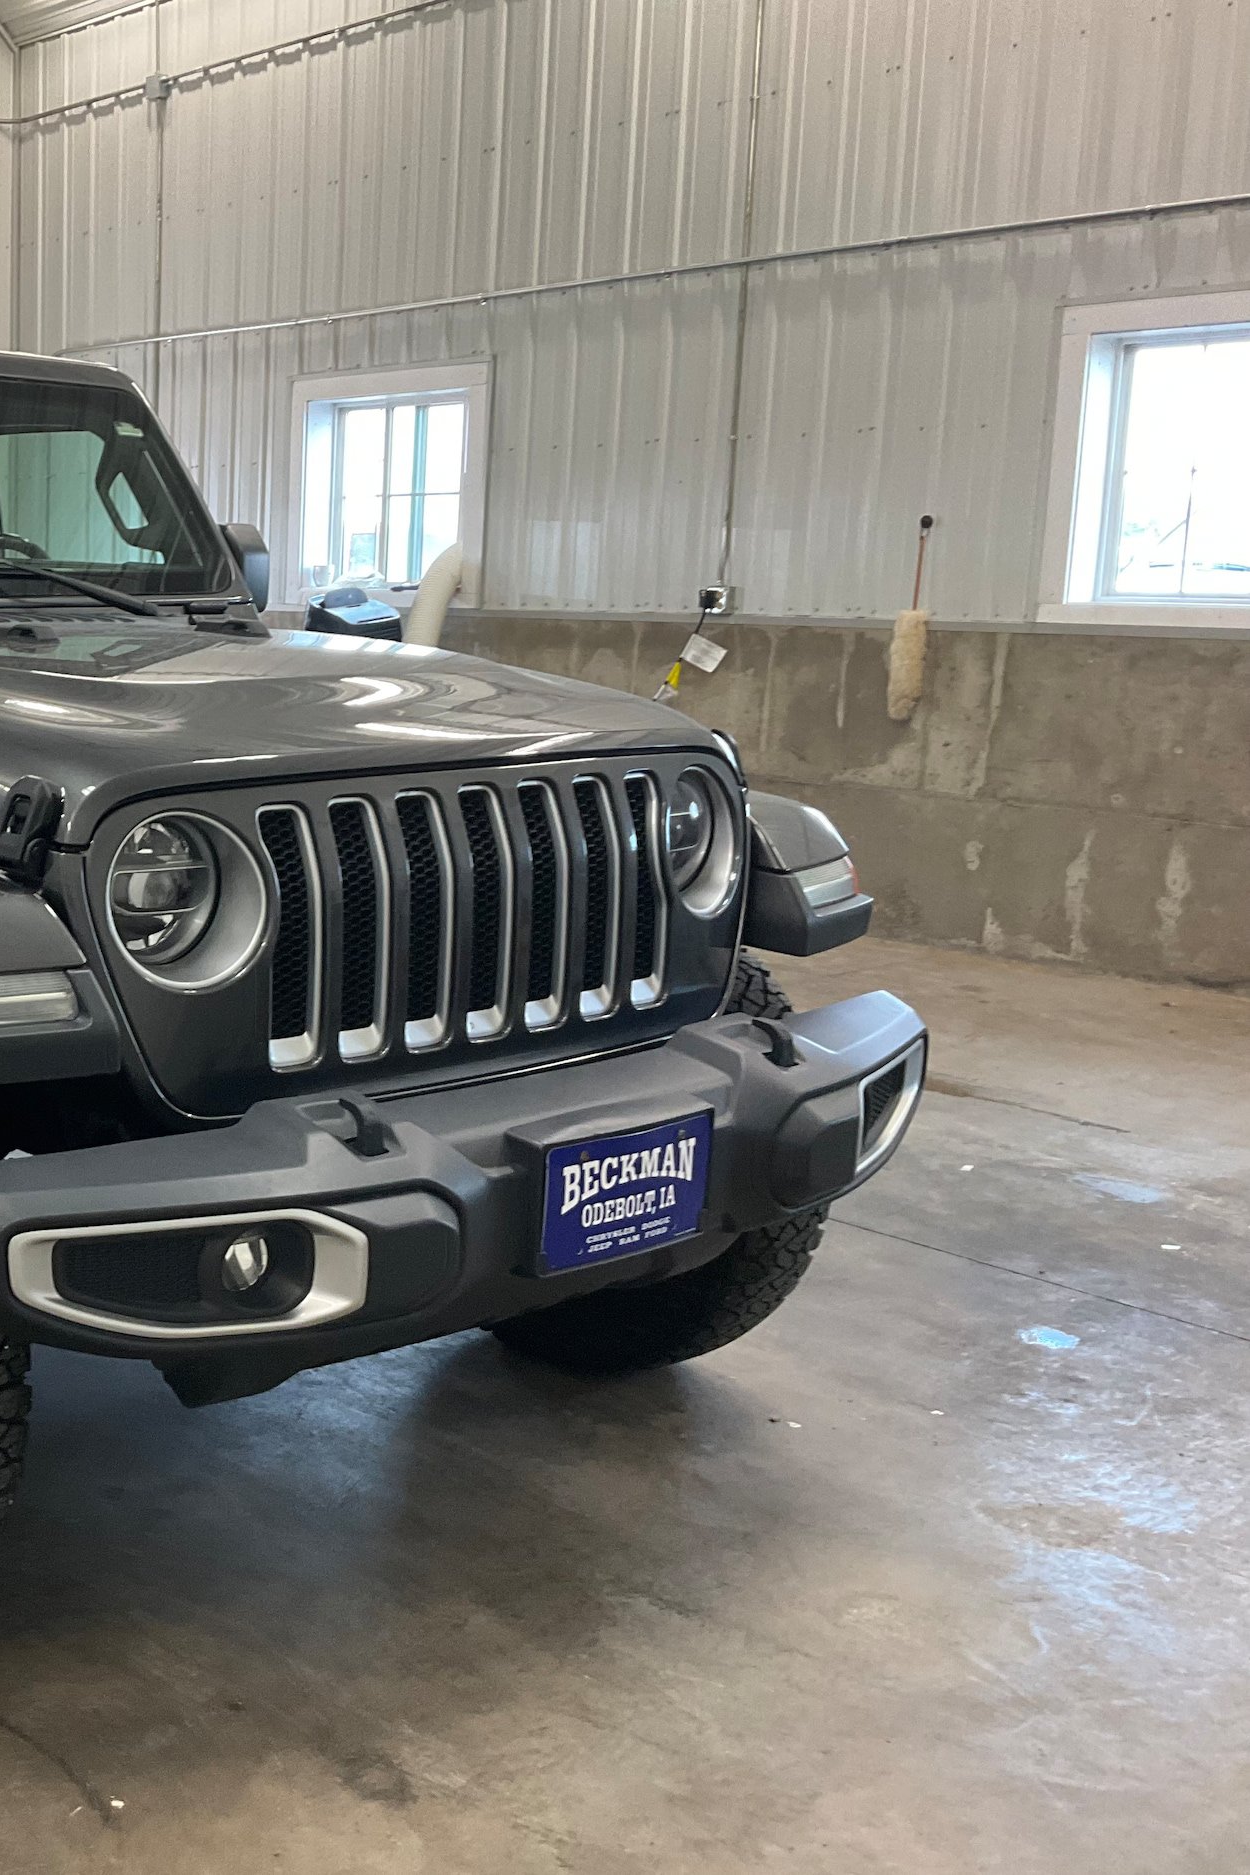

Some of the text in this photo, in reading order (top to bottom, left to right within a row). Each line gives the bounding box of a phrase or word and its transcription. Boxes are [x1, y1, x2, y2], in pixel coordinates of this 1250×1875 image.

[561, 1137, 696, 1215] BECKMAN
[581, 1184, 676, 1228] ODEBOLT, IA
[585, 1216, 671, 1244] CHRYSLER DODGE
[587, 1241, 613, 1253] JEEP
[618, 1233, 641, 1246] RAM
[644, 1226, 668, 1239] FORD
